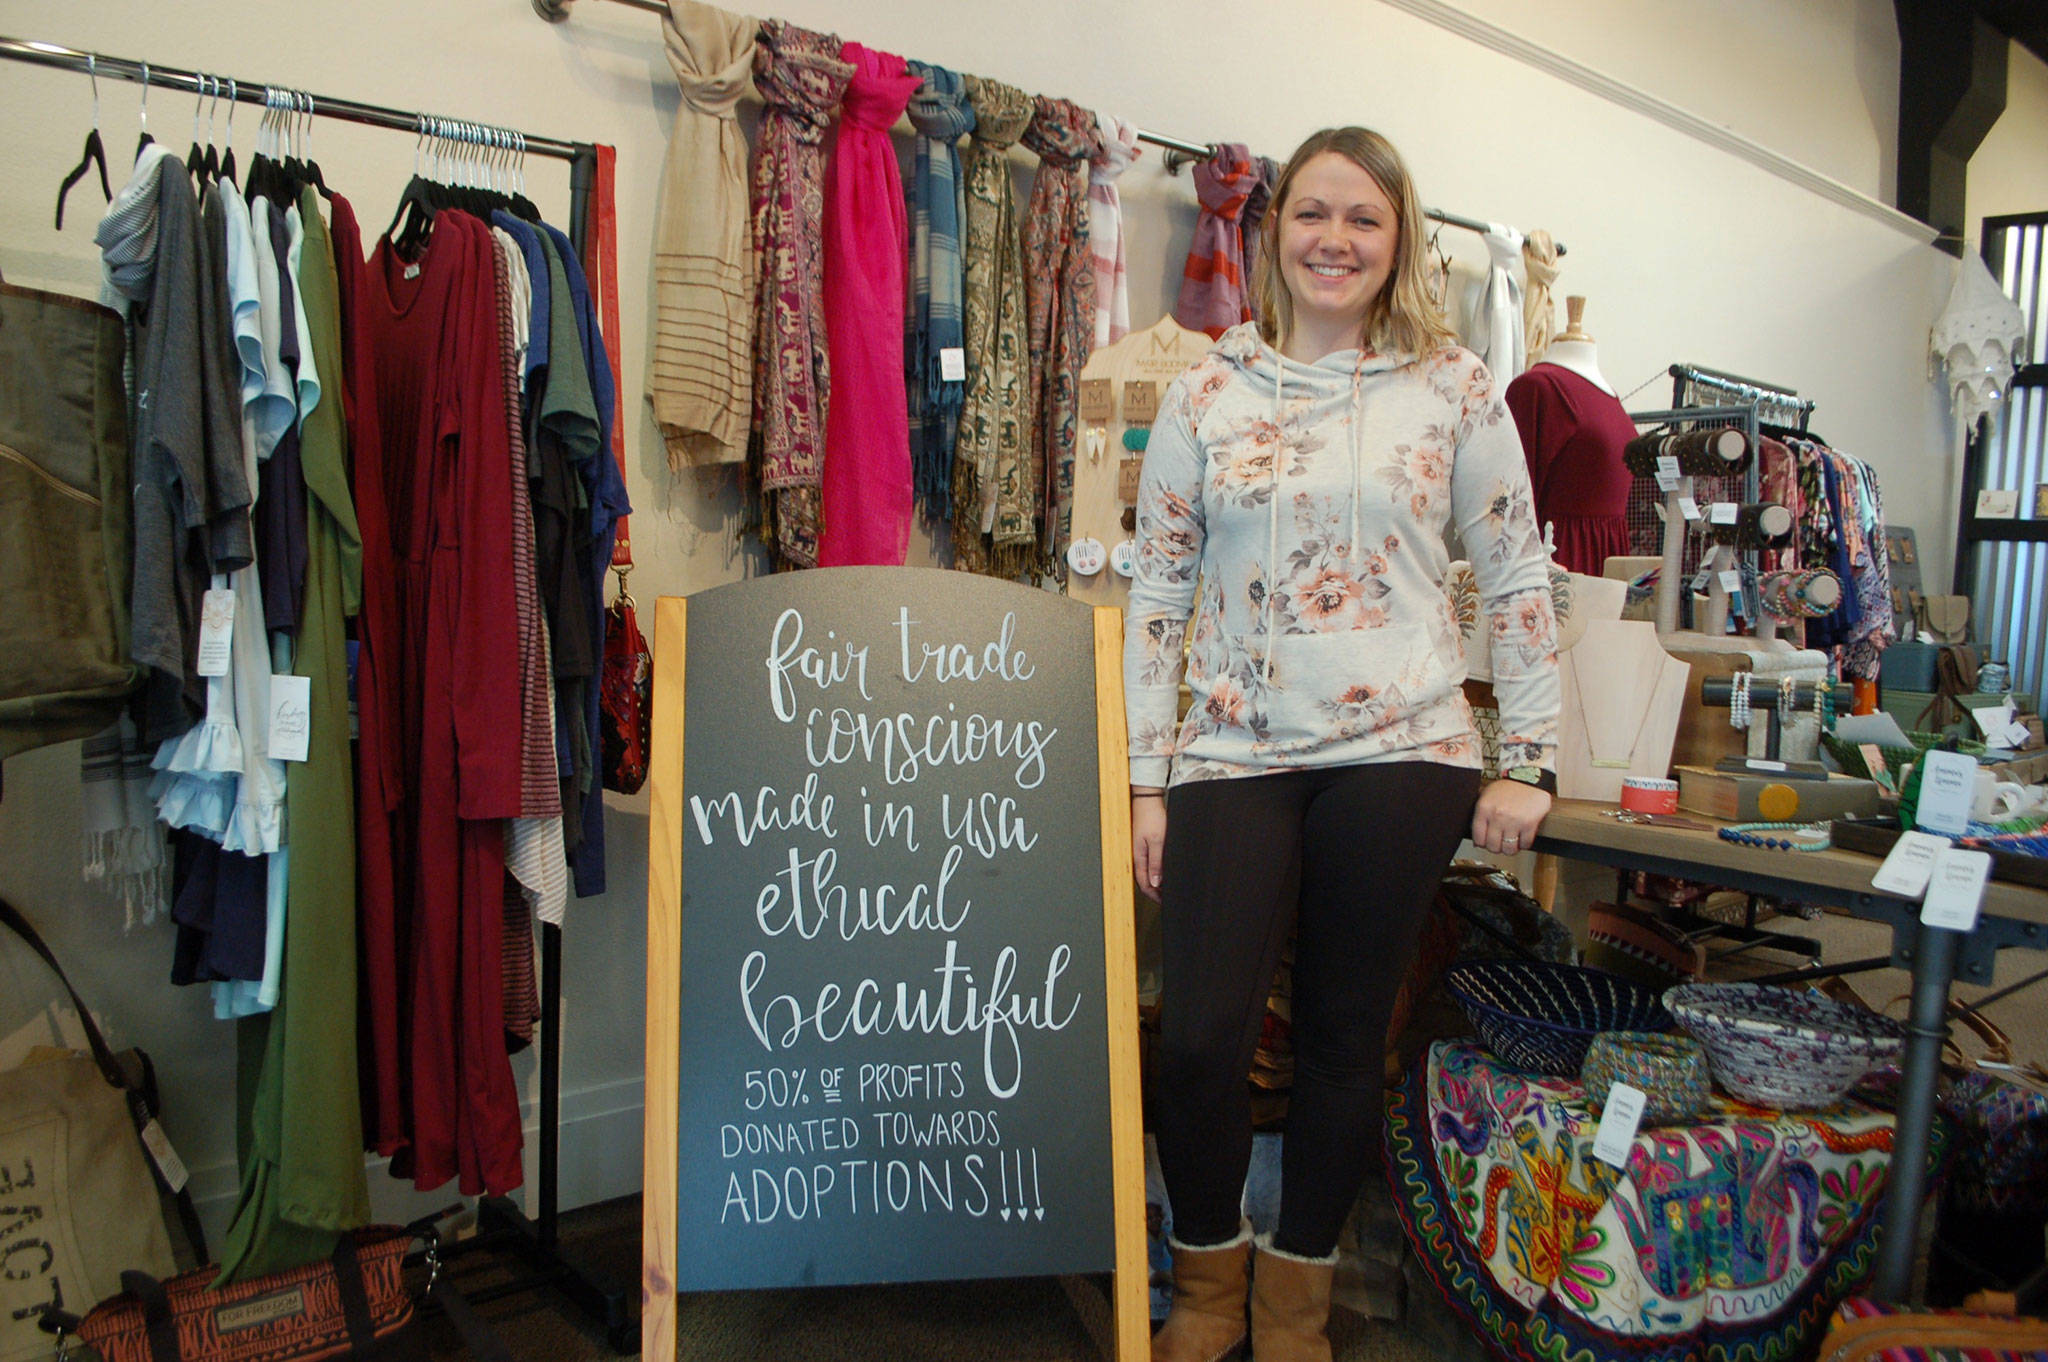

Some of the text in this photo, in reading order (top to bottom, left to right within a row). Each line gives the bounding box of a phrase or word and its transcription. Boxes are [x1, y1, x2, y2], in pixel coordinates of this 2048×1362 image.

[766, 606, 1036, 723] fair trade
[804, 702, 1058, 790] conscious
[689, 772, 1039, 860] made in usa
[756, 844, 972, 941] ethical
[740, 940, 1082, 1099] beautiful
[744, 1060, 966, 1110] 50% OF PROFITS
[721, 1110, 1001, 1159] DONATED TOWARDS
